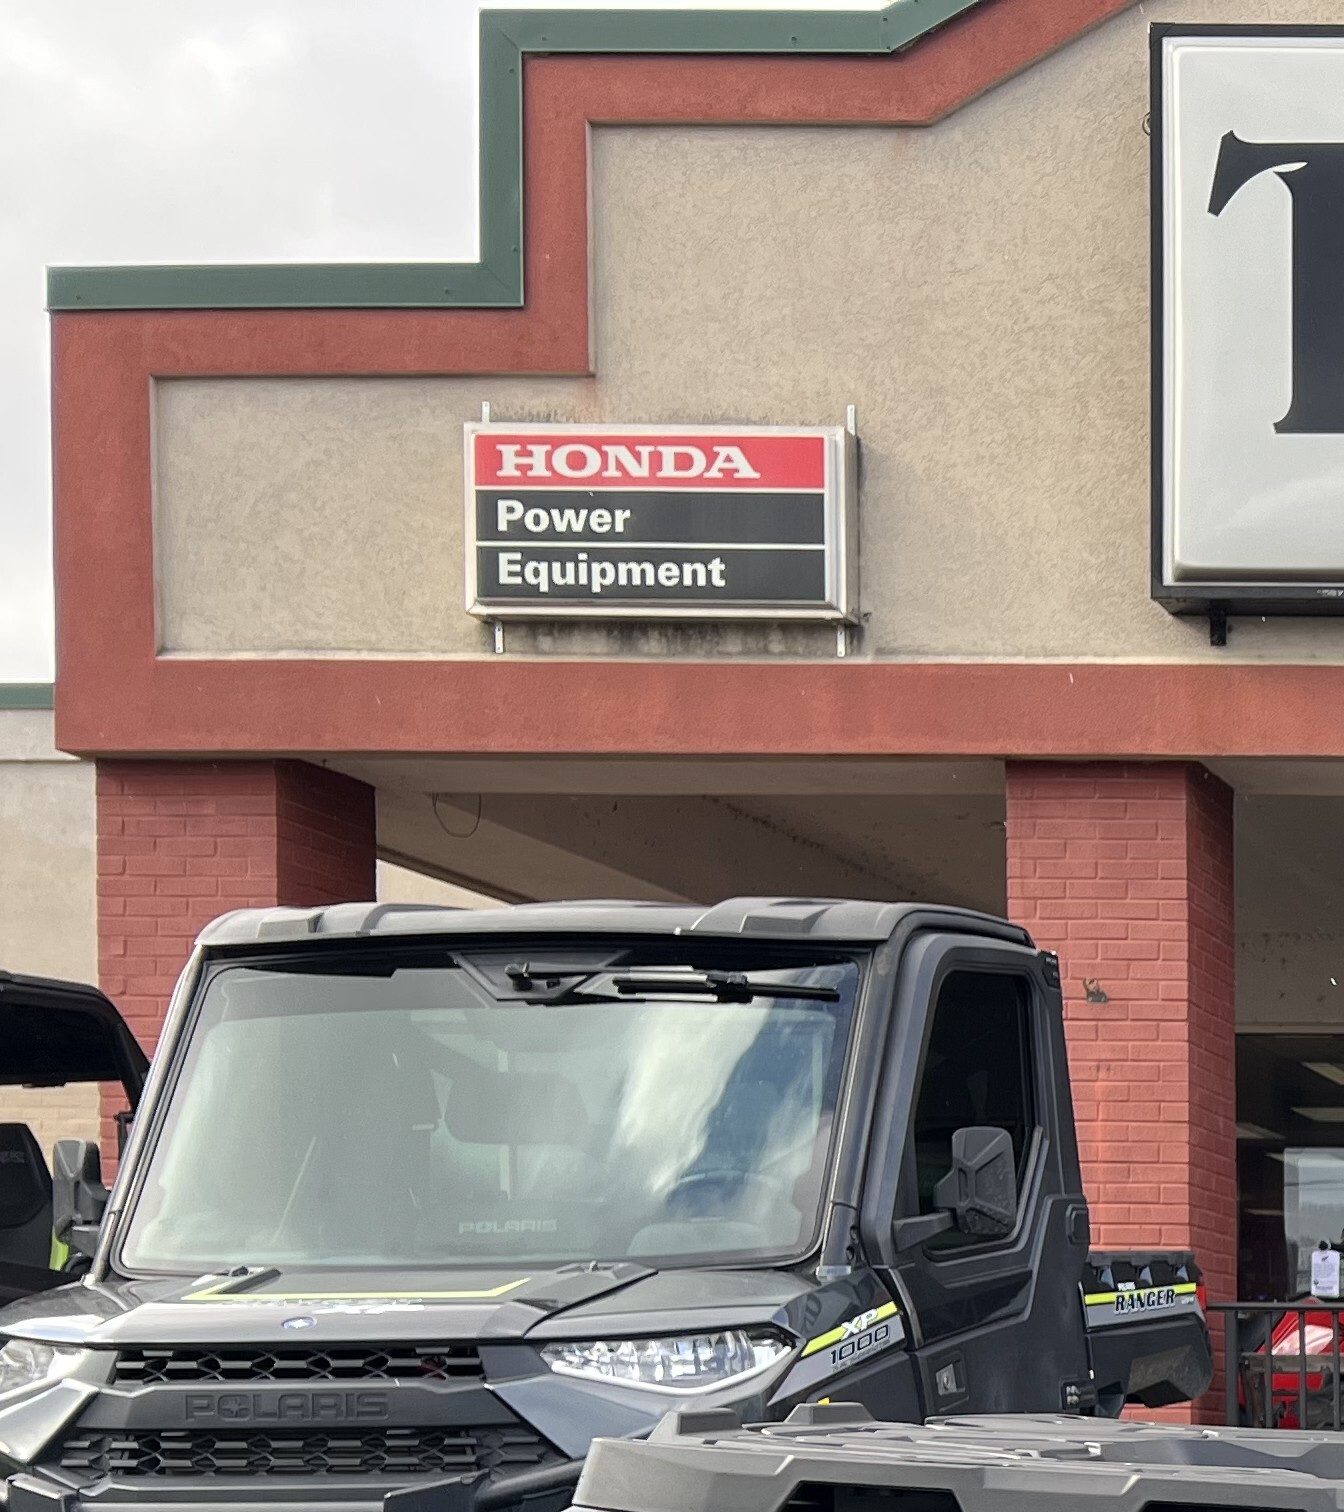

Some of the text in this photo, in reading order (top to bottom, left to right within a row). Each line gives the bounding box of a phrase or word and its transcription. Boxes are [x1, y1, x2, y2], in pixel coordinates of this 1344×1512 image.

[496, 444, 760, 479] HONDA
[497, 499, 631, 533] Power
[498, 552, 726, 593] Equipment
[458, 1219, 558, 1234] POLARIS
[1113, 1287, 1177, 1315] RANGER
[841, 1308, 879, 1341] XP
[830, 1324, 889, 1365] 1000
[184, 1392, 390, 1423] POLARIS
